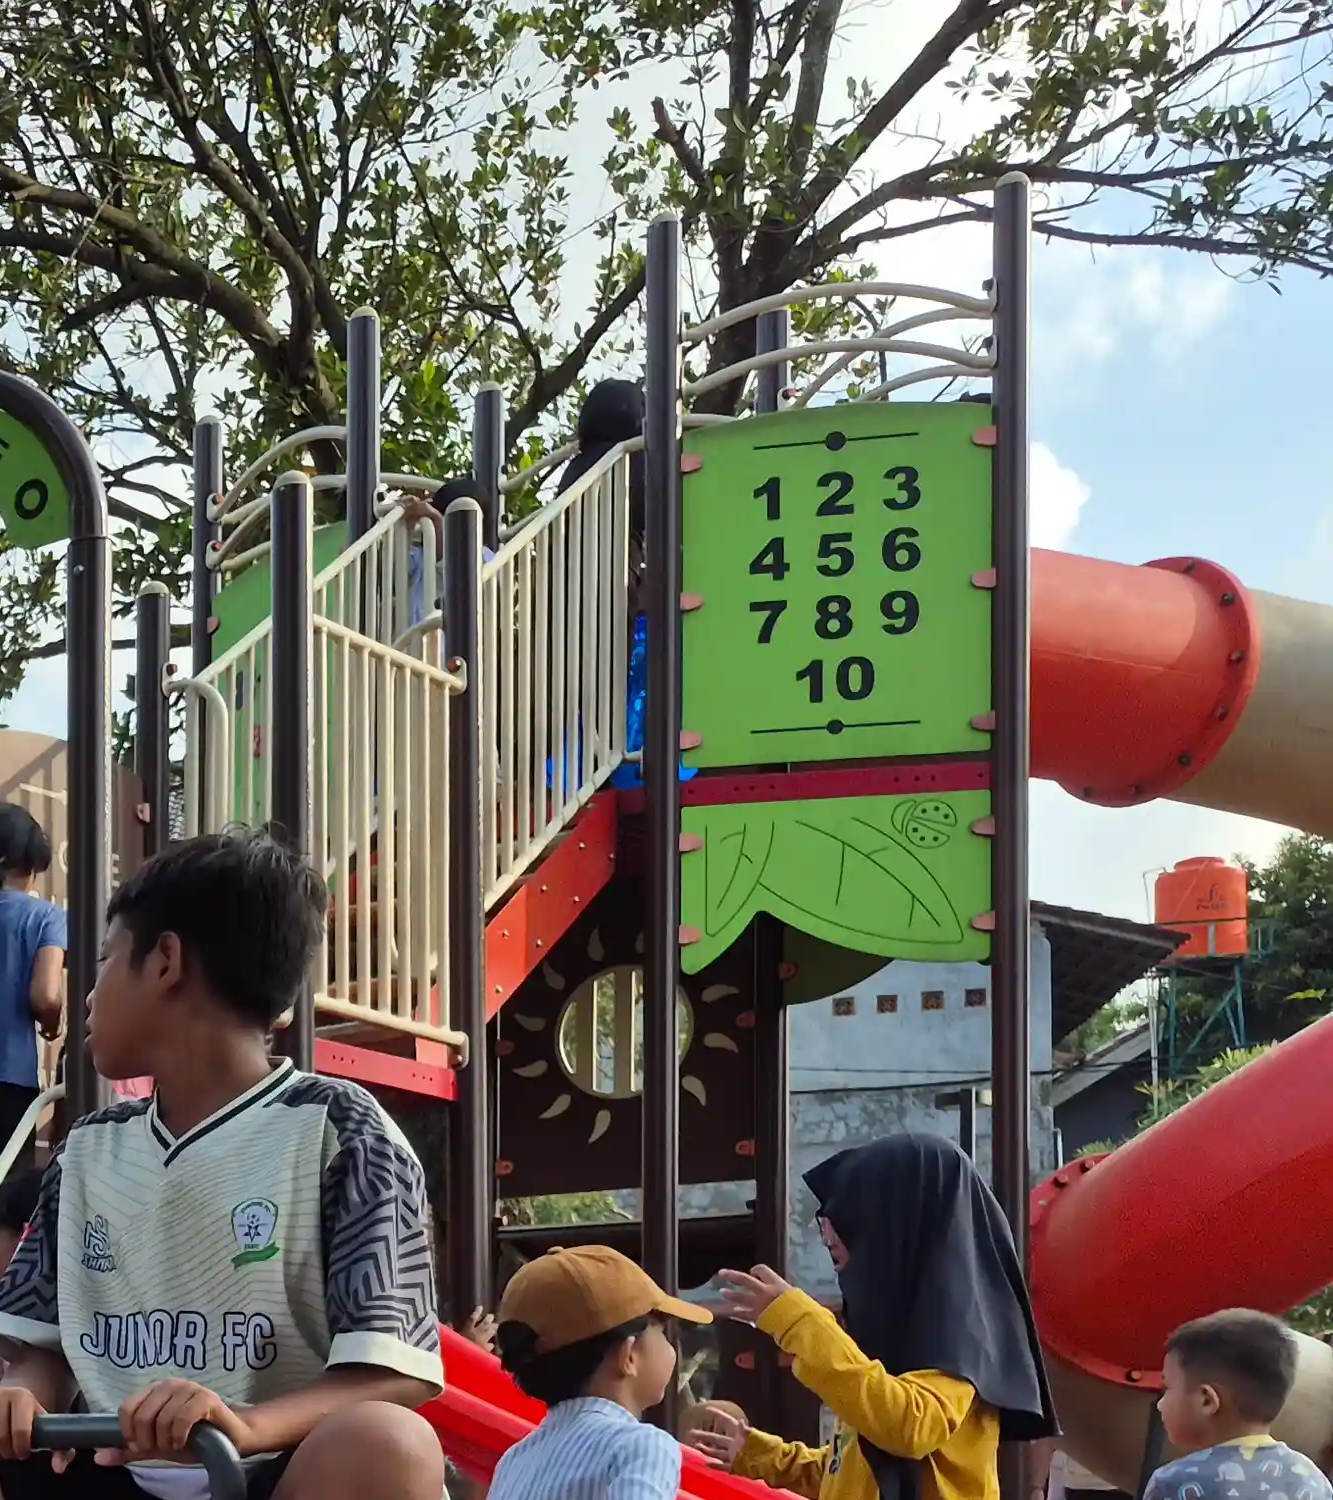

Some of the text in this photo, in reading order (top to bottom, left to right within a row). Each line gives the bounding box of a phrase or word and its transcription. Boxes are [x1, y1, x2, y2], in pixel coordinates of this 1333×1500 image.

[752, 465, 922, 521] 1 2 3
[748, 526, 922, 581] 4 5 6
[748, 590, 920, 644] 7 8 9
[794, 656, 876, 704] 10
[221, 1311, 278, 1372] FC
